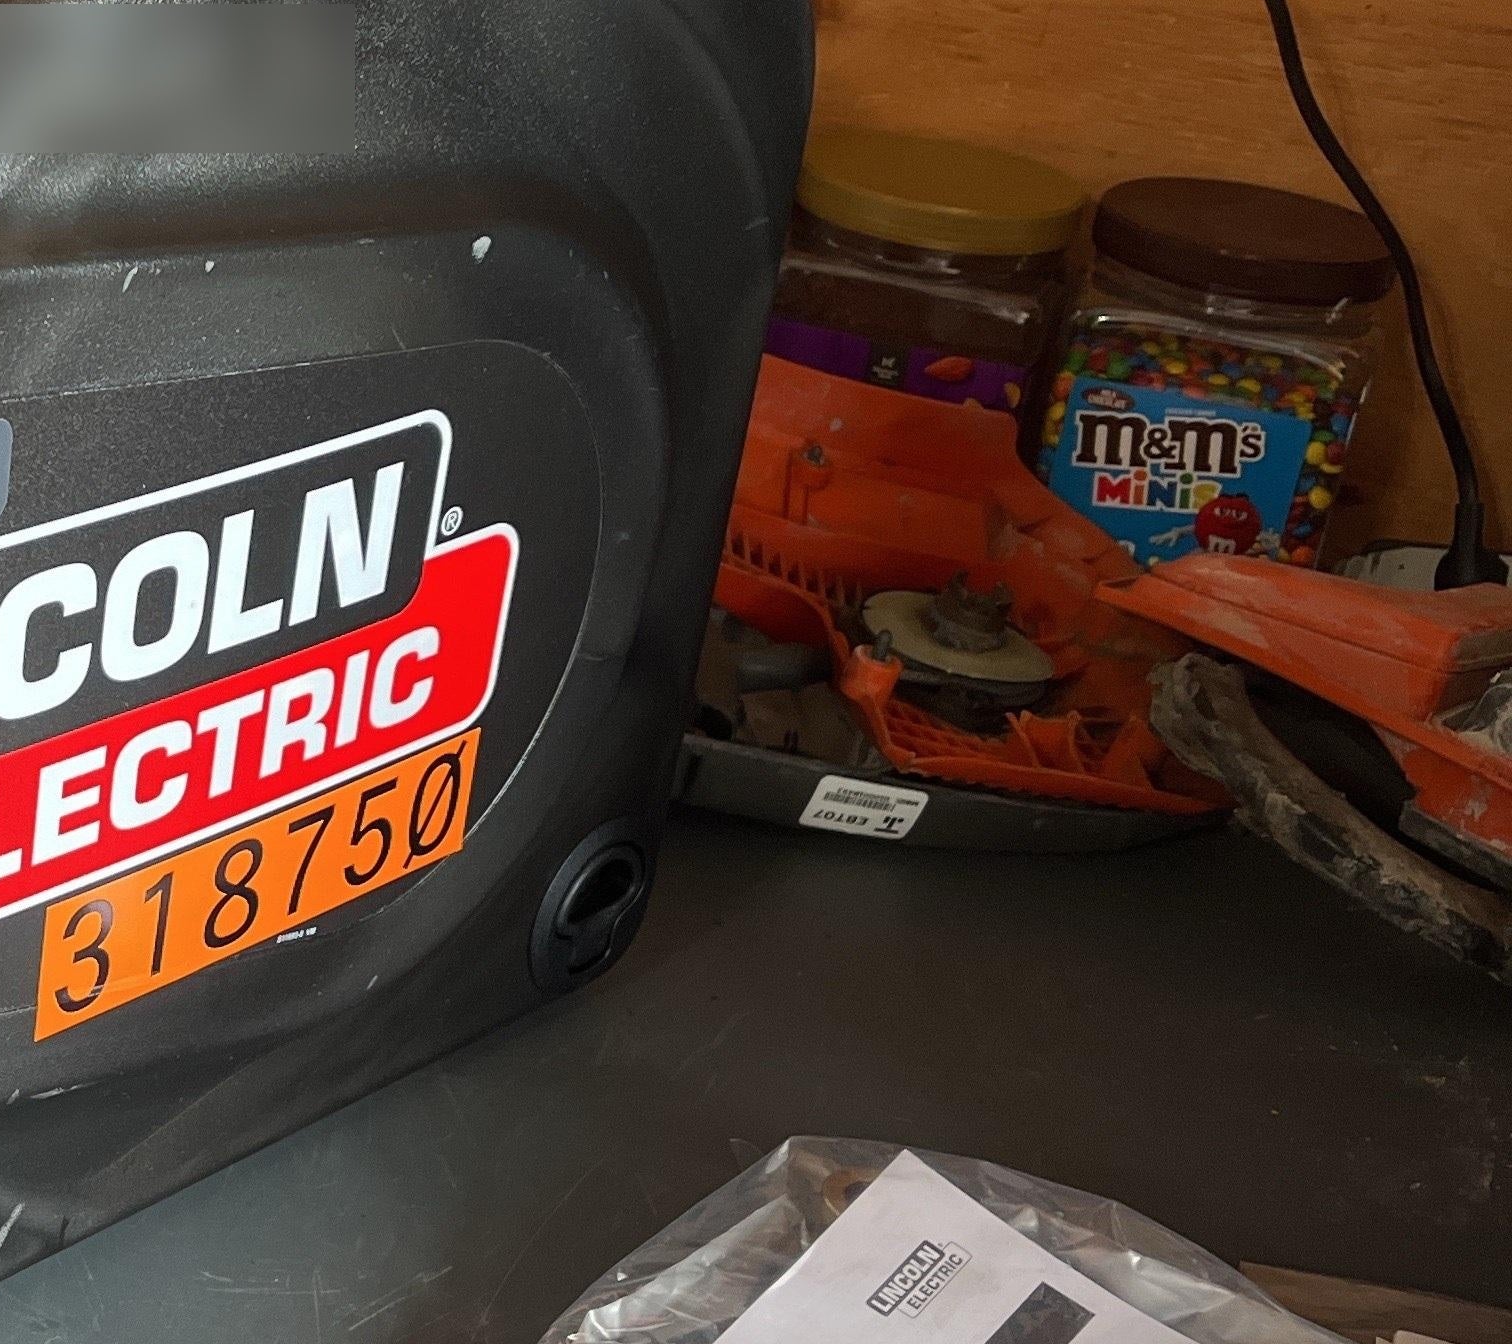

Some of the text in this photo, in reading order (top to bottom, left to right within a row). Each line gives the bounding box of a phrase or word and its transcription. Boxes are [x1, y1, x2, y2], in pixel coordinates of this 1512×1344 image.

[54, 741, 465, 1013] 318750
[870, 1243, 942, 1313] LINCOLN
[906, 1253, 963, 1311] ELECTRIC
